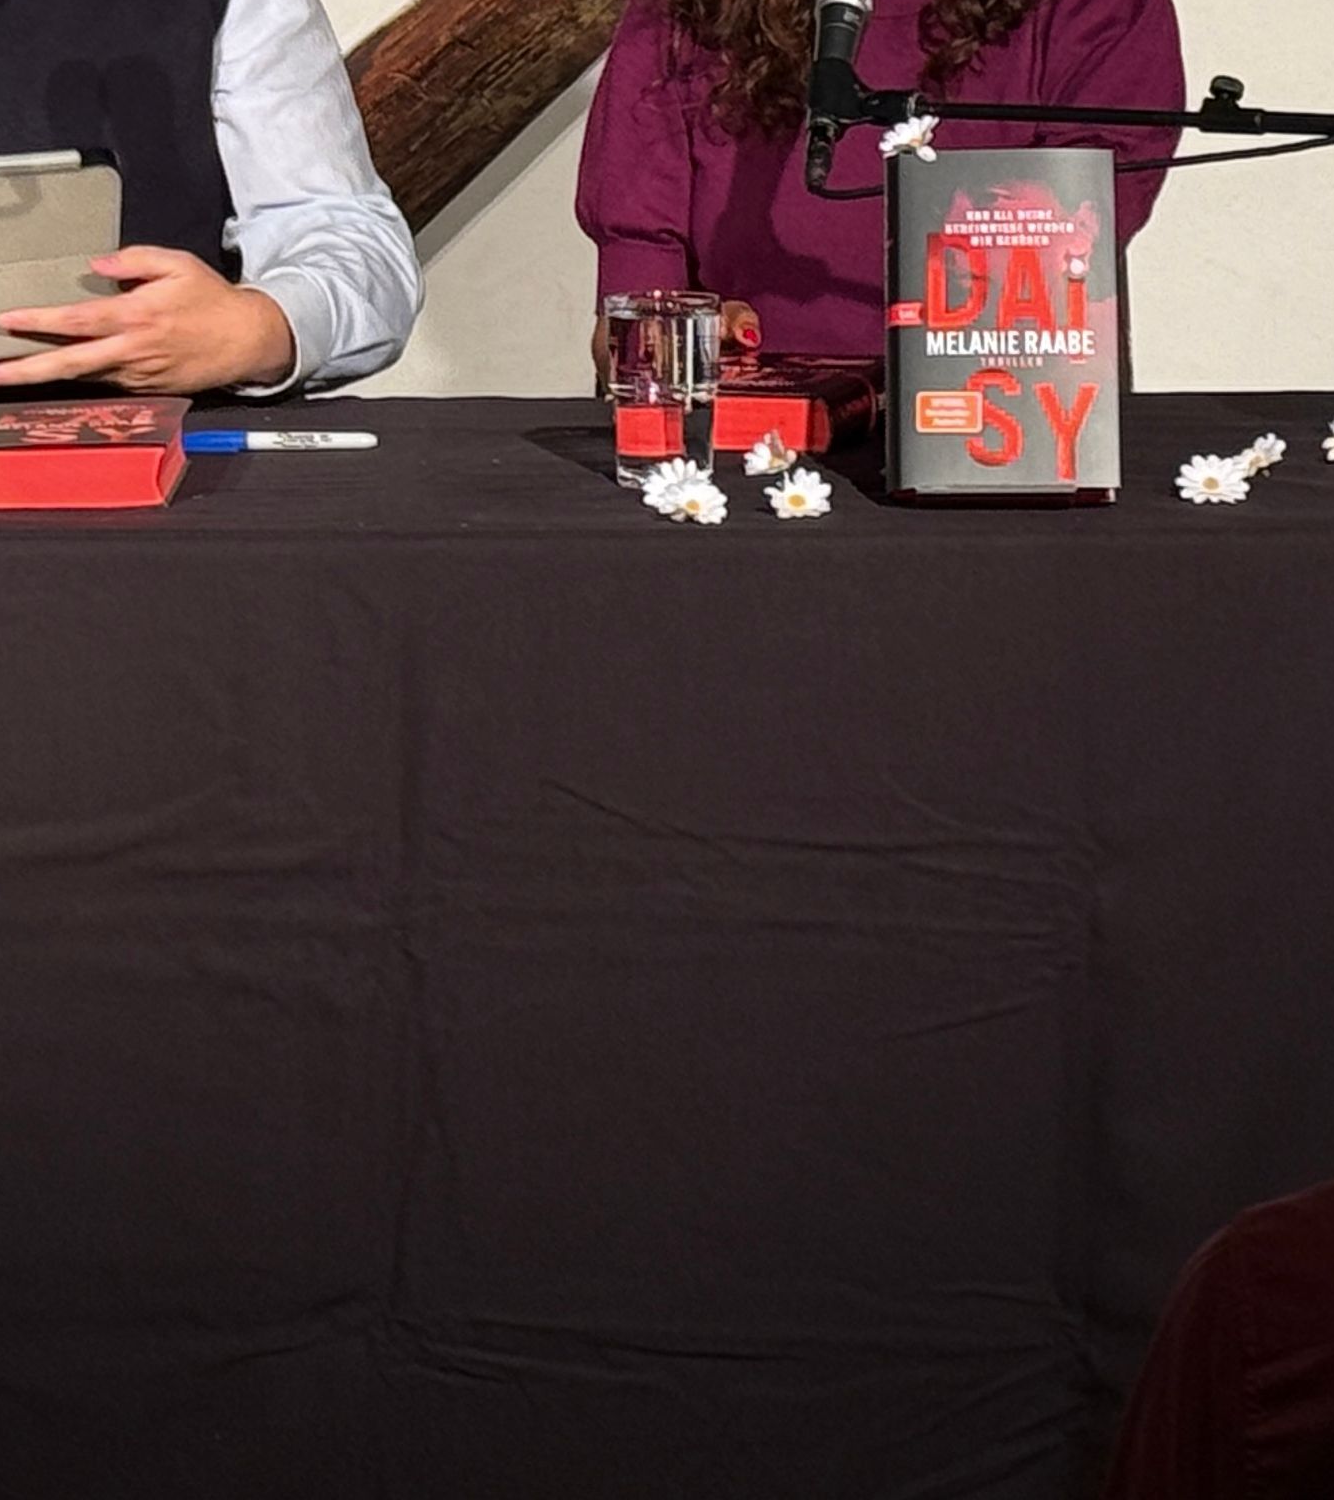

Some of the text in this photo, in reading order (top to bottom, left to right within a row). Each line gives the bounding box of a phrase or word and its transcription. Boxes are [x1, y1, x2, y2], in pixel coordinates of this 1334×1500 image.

[926, 330, 1095, 356] MELANIE RAABE
[966, 367, 1100, 482] SY
